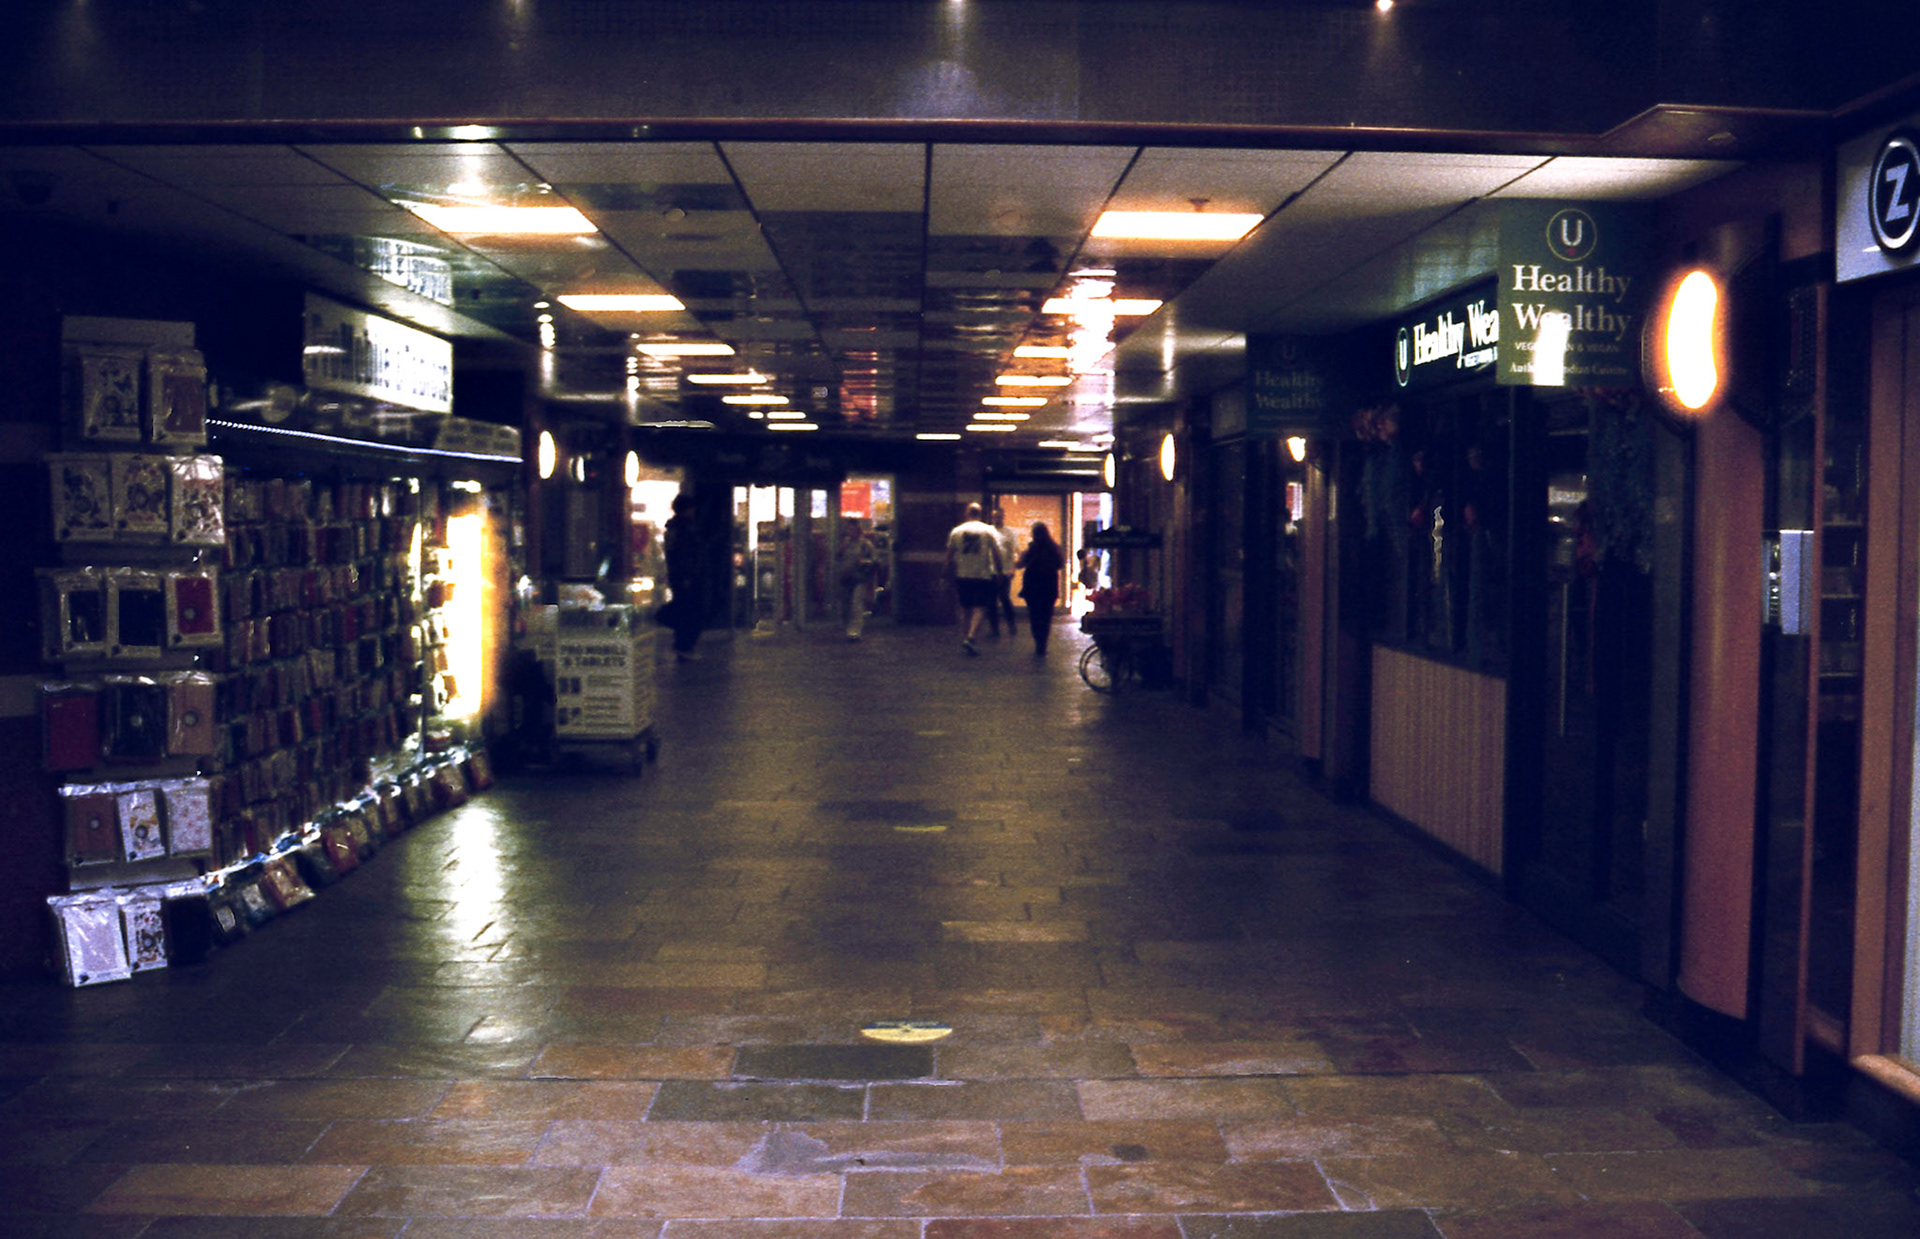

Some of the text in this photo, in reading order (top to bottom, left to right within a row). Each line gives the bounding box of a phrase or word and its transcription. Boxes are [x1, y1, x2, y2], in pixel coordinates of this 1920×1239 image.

[1885, 162, 1910, 223] Z
[1561, 218, 1582, 247] U
[1512, 264, 1631, 303] Healthy
[1413, 311, 1465, 369] Healthy
[1255, 370, 1322, 393] Healthy
[1255, 392, 1326, 412] Wealthy
